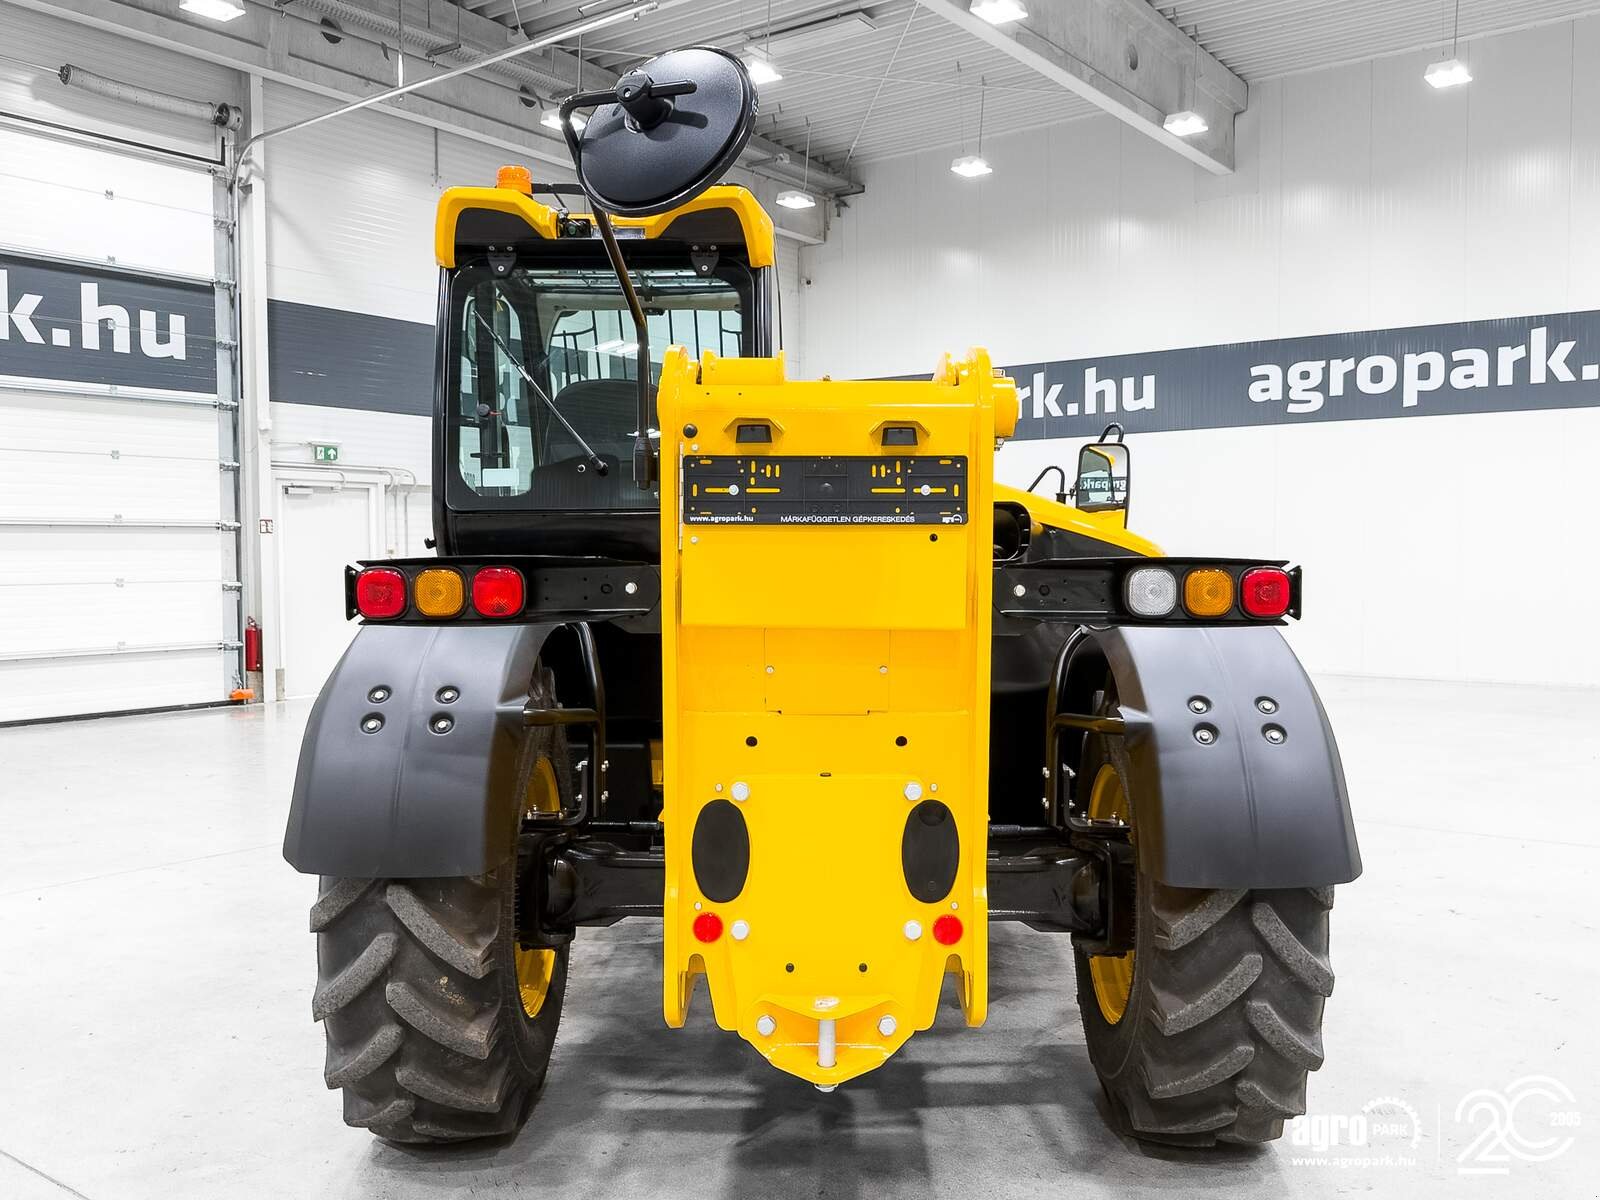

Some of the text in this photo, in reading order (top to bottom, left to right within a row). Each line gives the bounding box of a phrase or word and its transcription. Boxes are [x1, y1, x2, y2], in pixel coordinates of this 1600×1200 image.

[0, 269, 186, 360] k.hu
[1248, 326, 1599, 413] agropark.
[689, 515, 754, 523] www.agropark.hu
[852, 514, 915, 523] GÉPKERESKEDÉS
